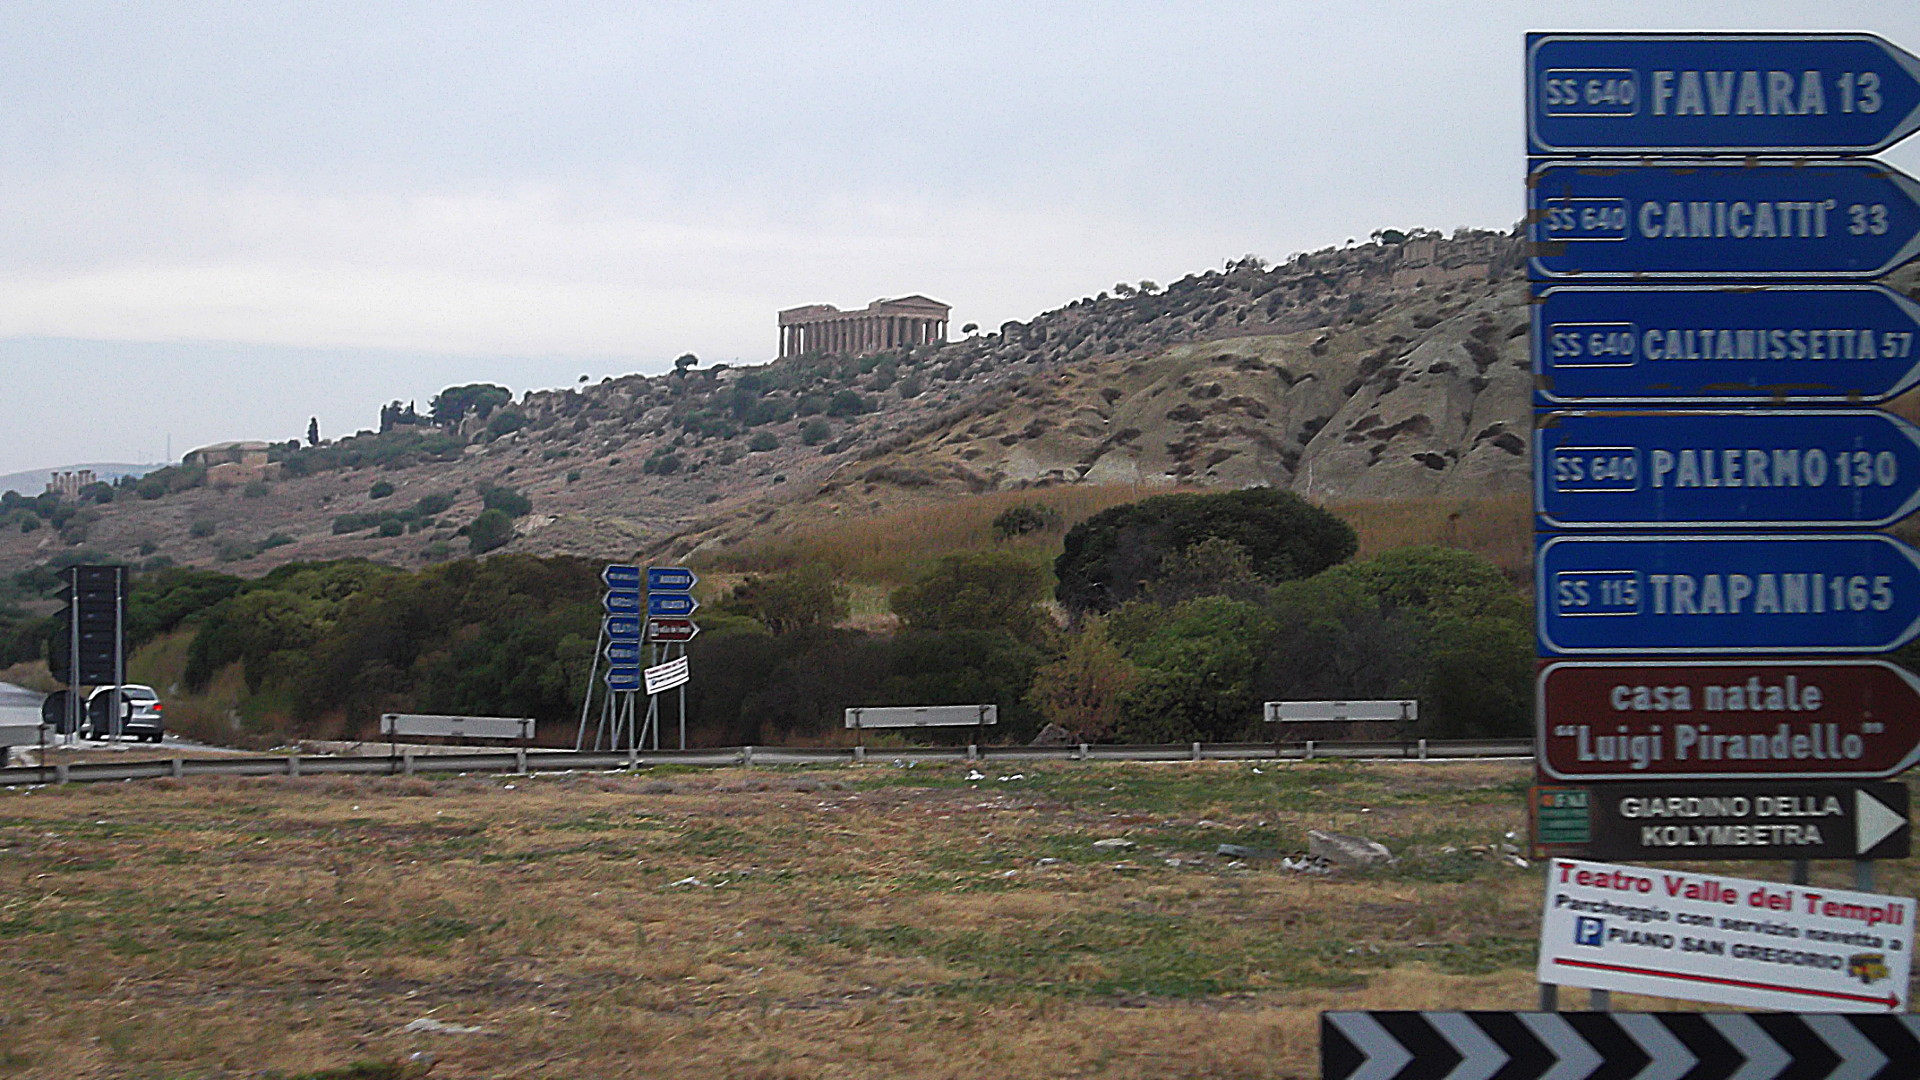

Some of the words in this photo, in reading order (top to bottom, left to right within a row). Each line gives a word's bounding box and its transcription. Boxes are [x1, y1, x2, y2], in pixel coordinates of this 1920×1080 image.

[1547, 79, 1576, 105] SS
[1584, 79, 1636, 105] 640
[1652, 71, 1827, 115] FAVARA
[1837, 72, 1882, 113] 13
[1547, 207, 1576, 231] SS
[1580, 207, 1627, 231] 640
[1848, 205, 1889, 235] 33
[1552, 333, 1582, 357] SS
[1588, 332, 1635, 356] 640
[1643, 329, 1877, 360] CALTANISSETTA
[1882, 332, 1913, 358] 57
[1554, 457, 1583, 481] SS
[1590, 457, 1637, 481] 640
[1650, 449, 1828, 488] PALERMO
[1836, 451, 1898, 487] 130
[1559, 581, 1589, 606] SS
[1600, 579, 1638, 605] 115
[1650, 574, 1826, 614] TRAPANI
[1830, 576, 1894, 611] 165
[1611, 684, 1691, 711] casa
[1705, 676, 1823, 711] natale
[1620, 796, 1751, 818] GIARDINO
[1755, 796, 1843, 817] DELLA
[1641, 825, 1823, 847] KOLYMBETRA
[1556, 862, 1653, 894] Teatro
[1664, 874, 1737, 905] Valle
[1748, 887, 1792, 911] dei
[1804, 893, 1904, 927] Templi
[1555, 894, 1670, 924] Parcheggio
[1677, 911, 1715, 926] con
[1720, 915, 1799, 938] servizio
[1805, 926, 1885, 949] navetta
[1888, 938, 1903, 951] a
[1608, 926, 1674, 950] PIANO
[1681, 936, 1725, 956] SAN
[1731, 943, 1843, 971] GREGORIO
